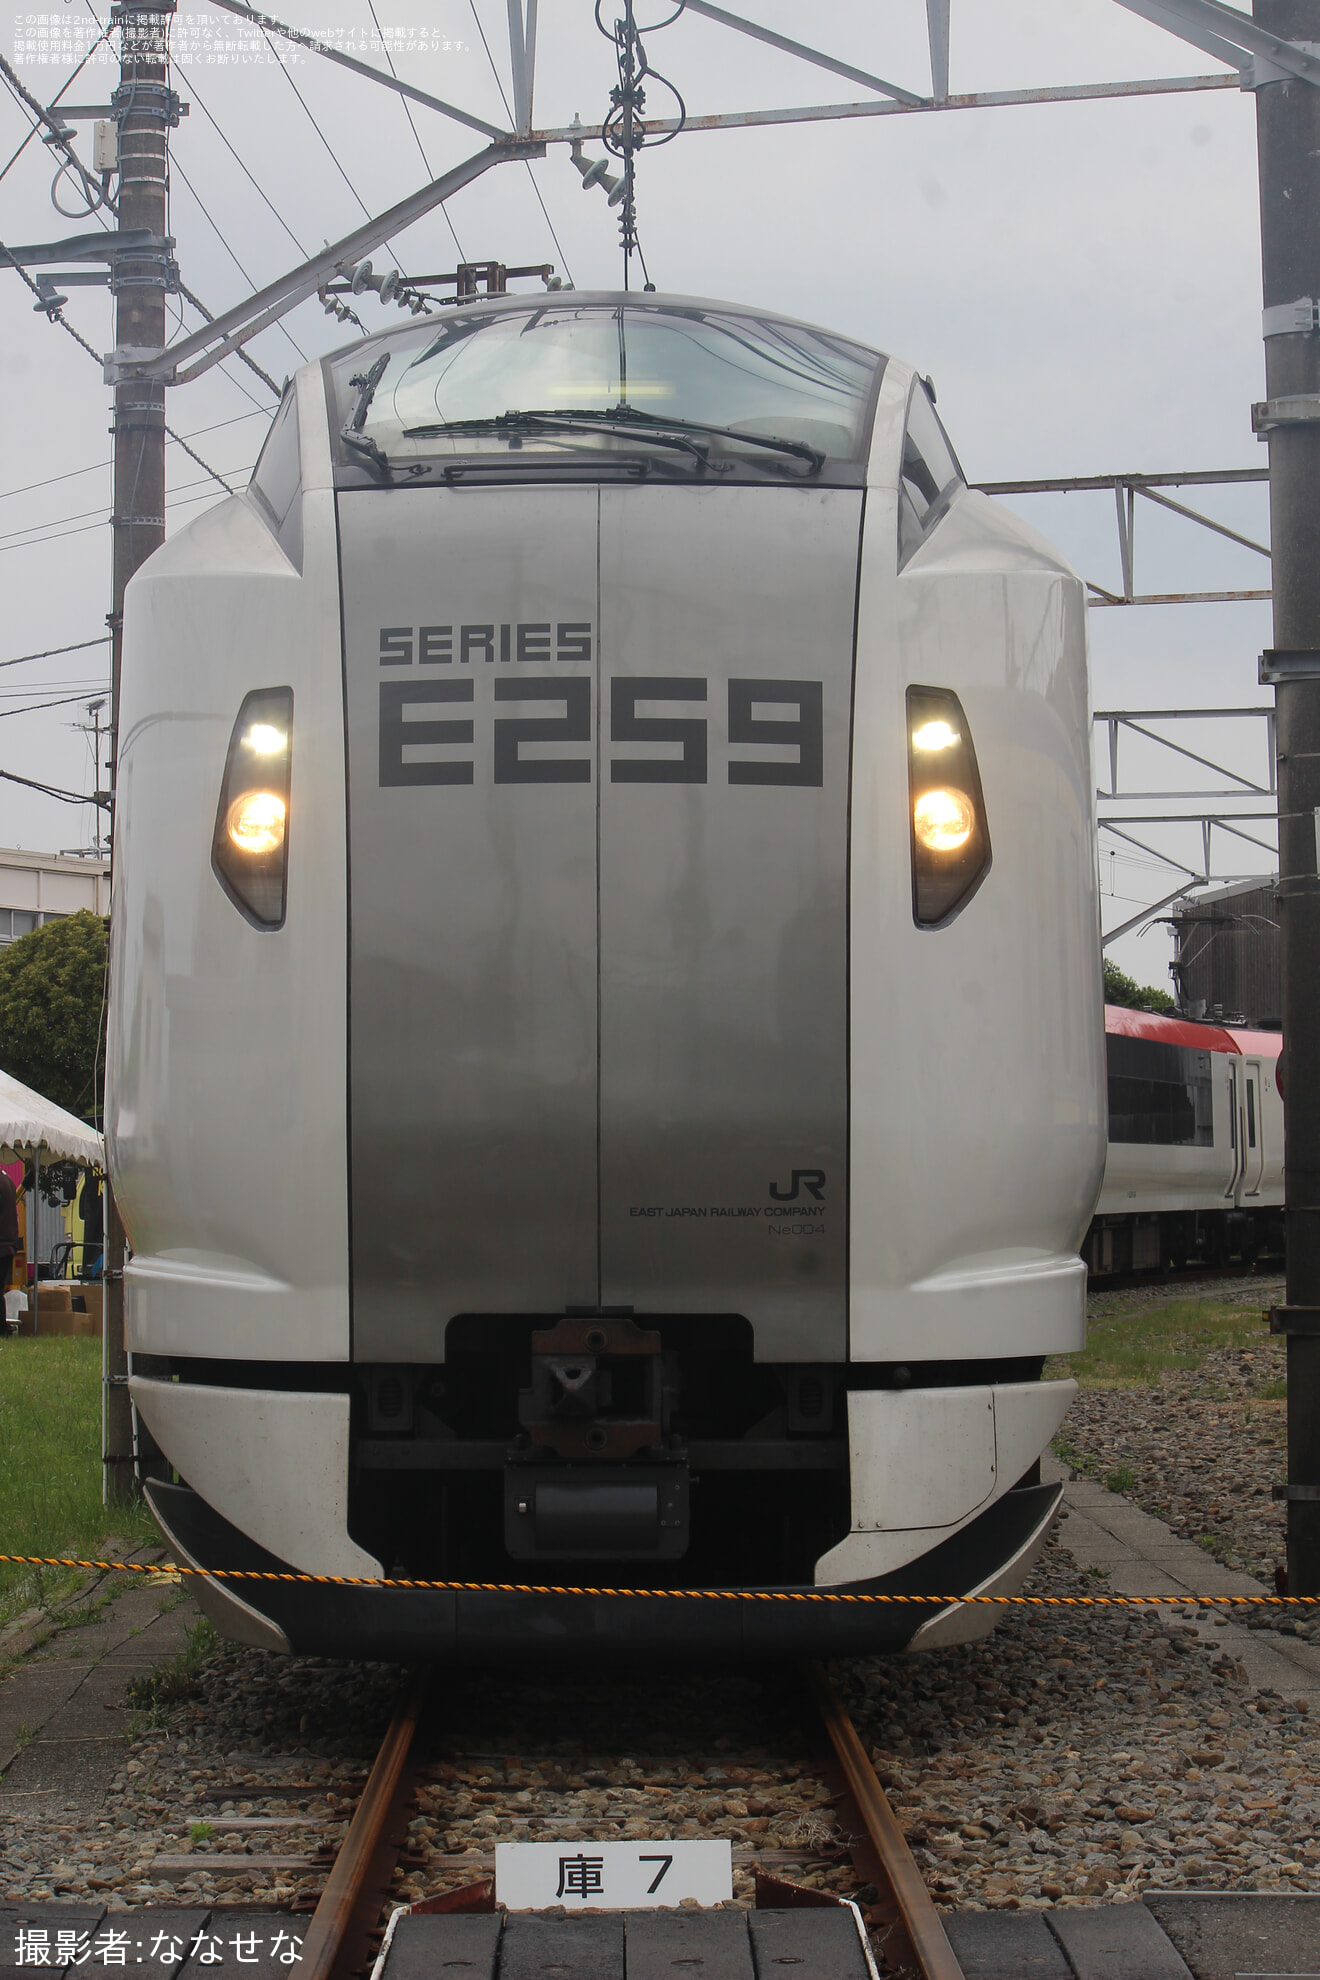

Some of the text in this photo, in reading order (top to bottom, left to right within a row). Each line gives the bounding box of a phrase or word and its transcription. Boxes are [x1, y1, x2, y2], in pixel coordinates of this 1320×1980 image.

[379, 623, 592, 666] SERIES
[379, 677, 823, 787] E259
[769, 1169, 826, 1201] JR
[629, 1206, 826, 1217] EAST JAPAN RAILWAY COMPANY
[768, 1223, 826, 1235] Ne004
[556, 1853, 673, 1899] 庫 7
